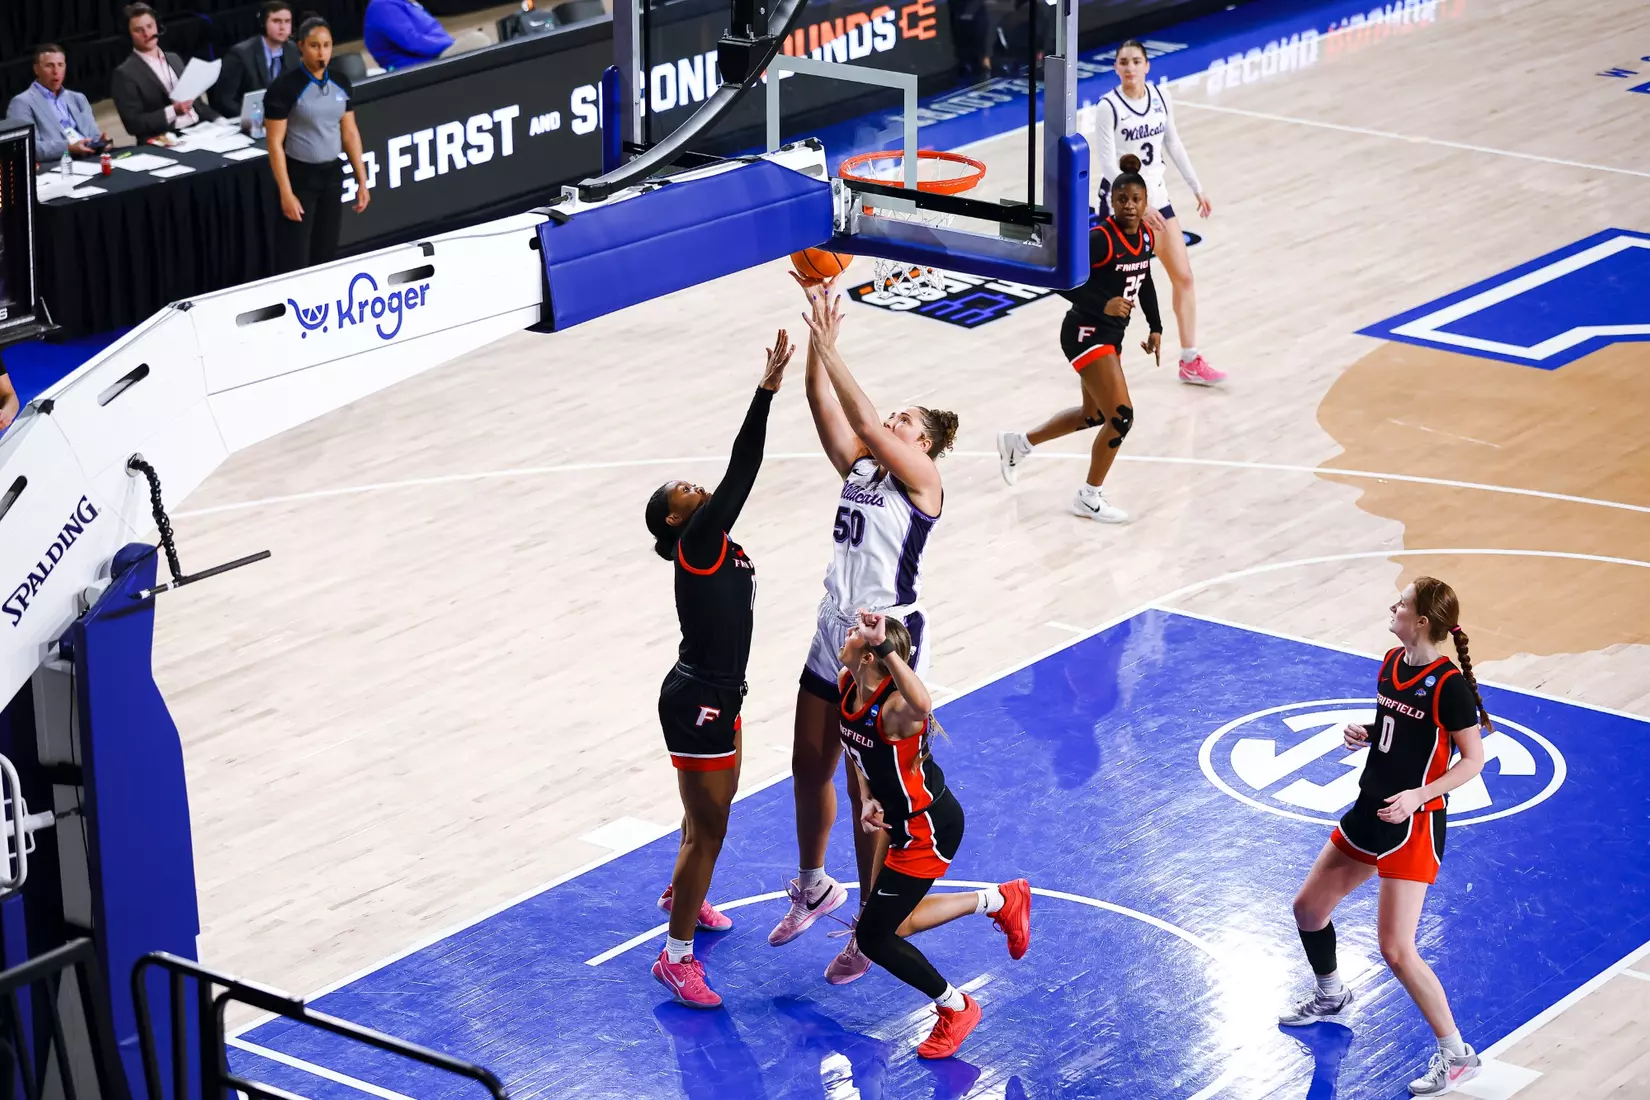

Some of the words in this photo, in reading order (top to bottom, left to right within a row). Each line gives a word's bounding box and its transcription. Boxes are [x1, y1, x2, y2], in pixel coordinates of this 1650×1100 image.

[387, 104, 520, 188] FIRST
[529, 111, 561, 136] AND
[571, 50, 726, 135] SOND
[1140, 142, 1154, 166] 3
[336, 272, 430, 340] Kroger
[1077, 326, 1096, 343] F
[833, 505, 866, 548] 50
[1, 494, 99, 628] SPALDING
[695, 705, 721, 727] F
[1378, 714, 1395, 754] 0
